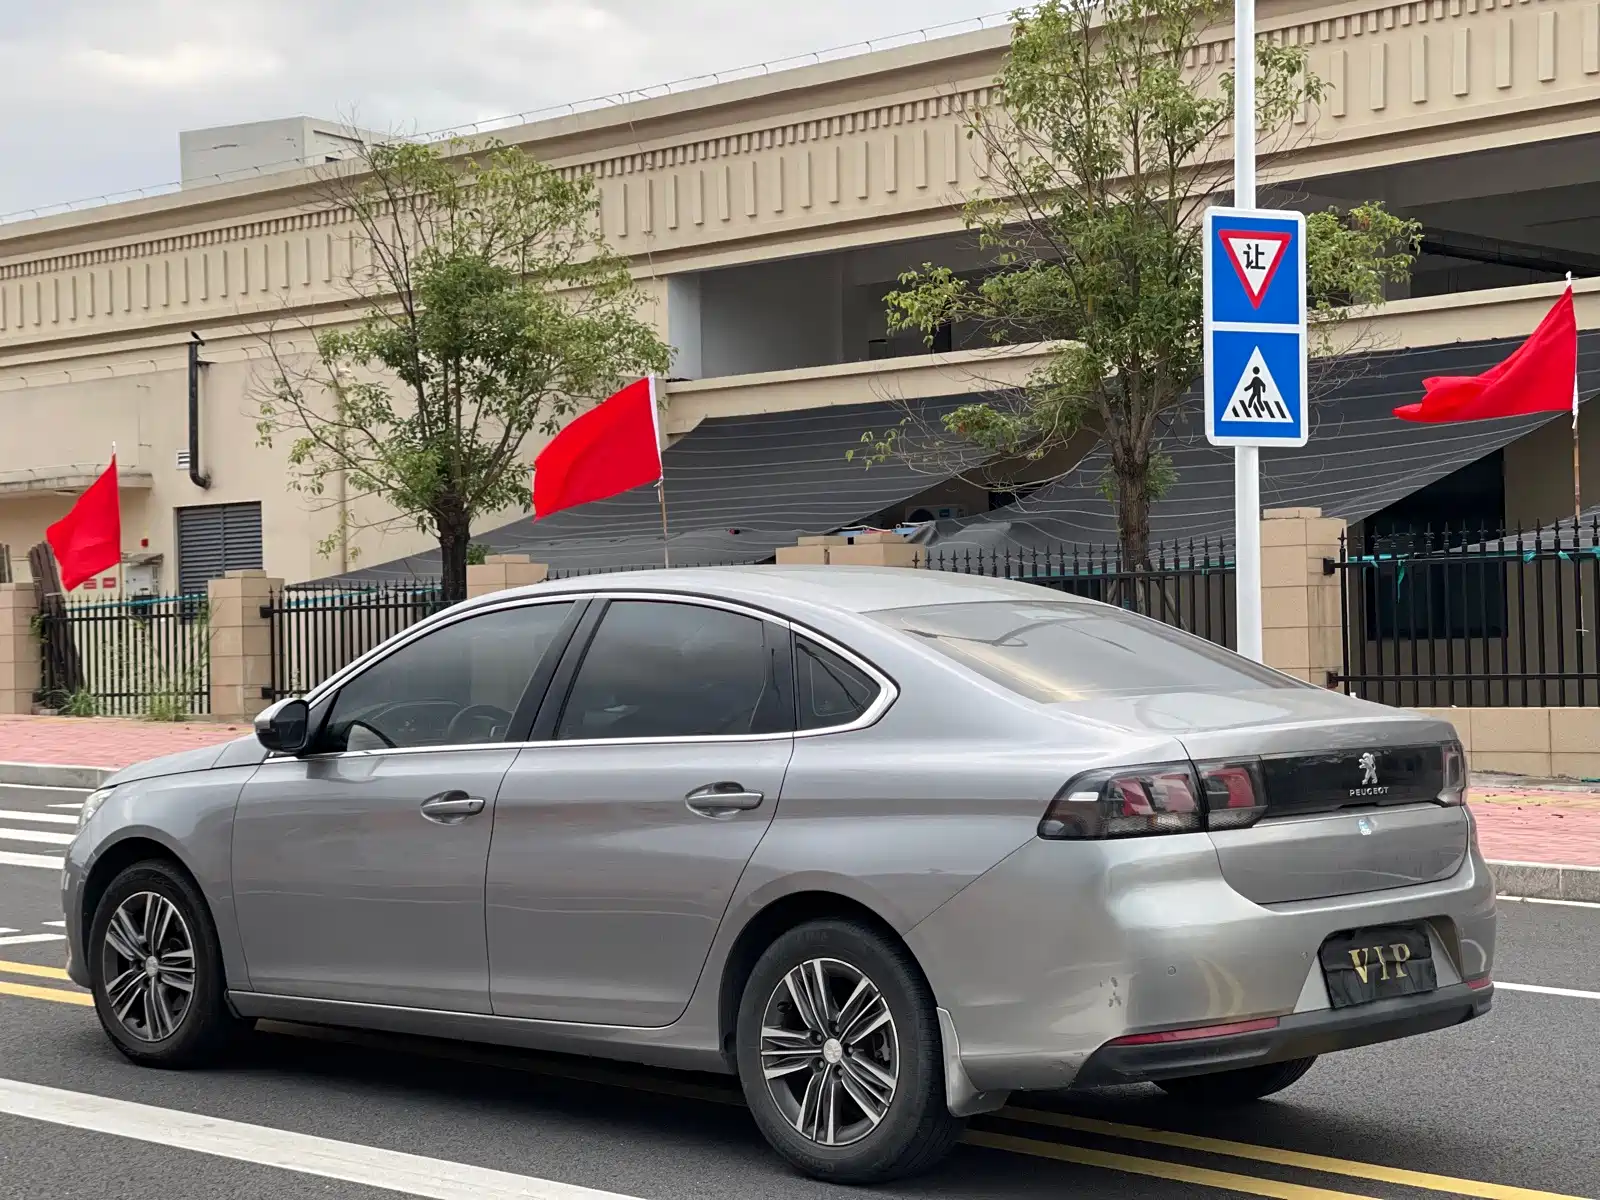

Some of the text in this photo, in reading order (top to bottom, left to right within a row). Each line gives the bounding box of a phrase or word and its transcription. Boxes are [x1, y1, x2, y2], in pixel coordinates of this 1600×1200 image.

[1243, 243, 1266, 270] 让
[1349, 786, 1389, 797] PEUGEOT
[1348, 943, 1411, 984] VIP
